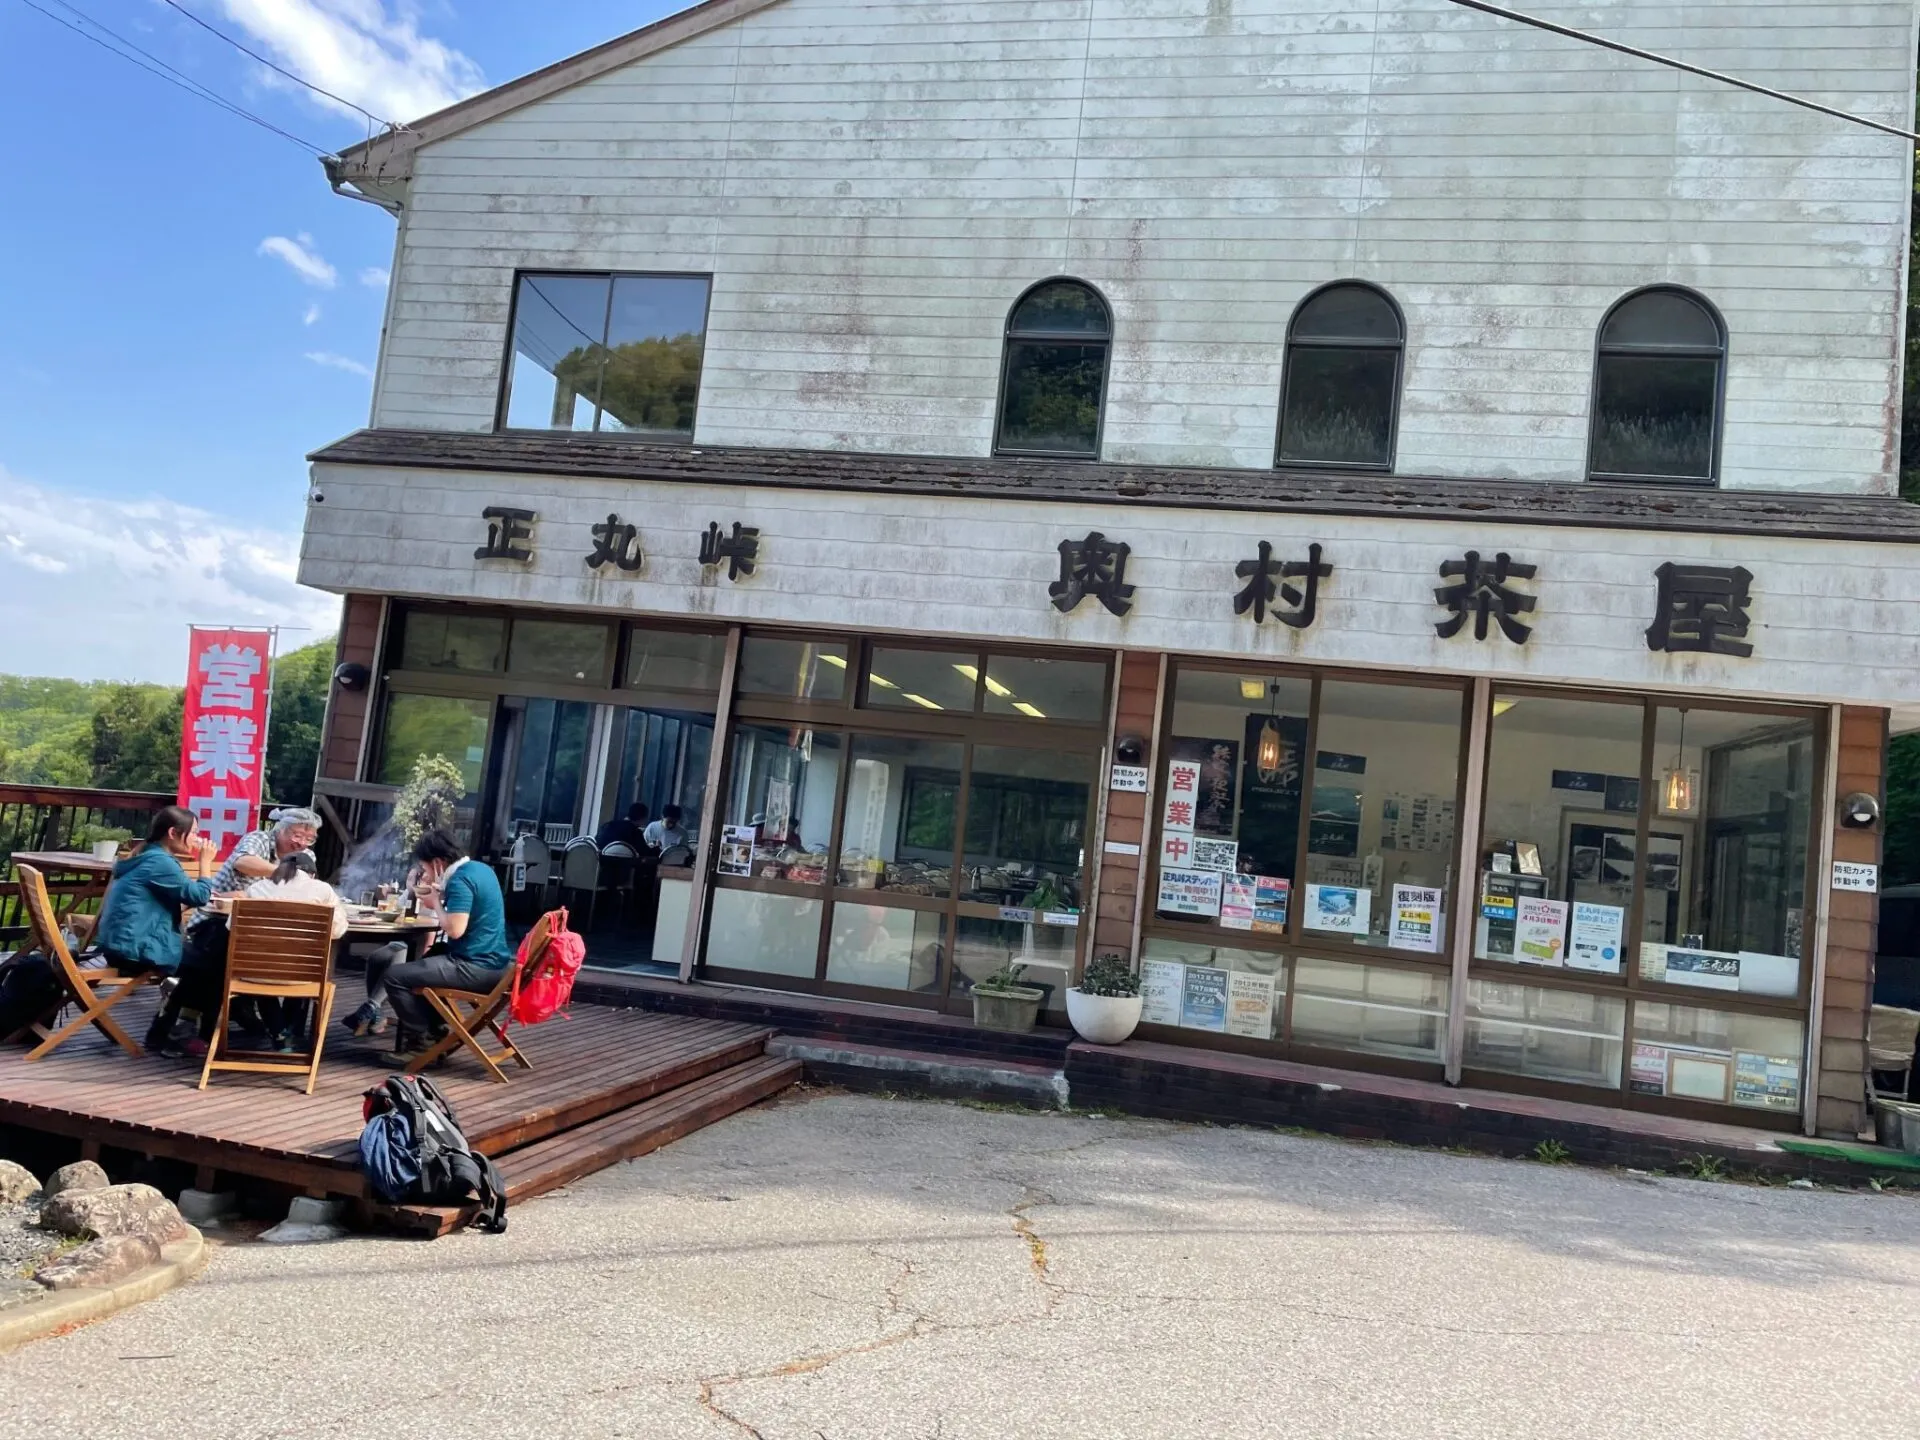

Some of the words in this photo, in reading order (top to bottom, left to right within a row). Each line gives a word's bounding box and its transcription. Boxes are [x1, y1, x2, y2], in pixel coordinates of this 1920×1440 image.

[474, 506, 760, 582] 正丸峠
[1048, 530, 1755, 658] 奥村茶屋
[188, 643, 262, 853] 営業中
[1113, 768, 1145, 778] 防犯カメラ
[1112, 779, 1134, 787] 作動中
[1165, 766, 1196, 862] 営業中
[1834, 864, 1873, 876] 防犯カメラ
[1834, 877, 1860, 886] 作動中
[1398, 890, 1436, 902] 復刻版
